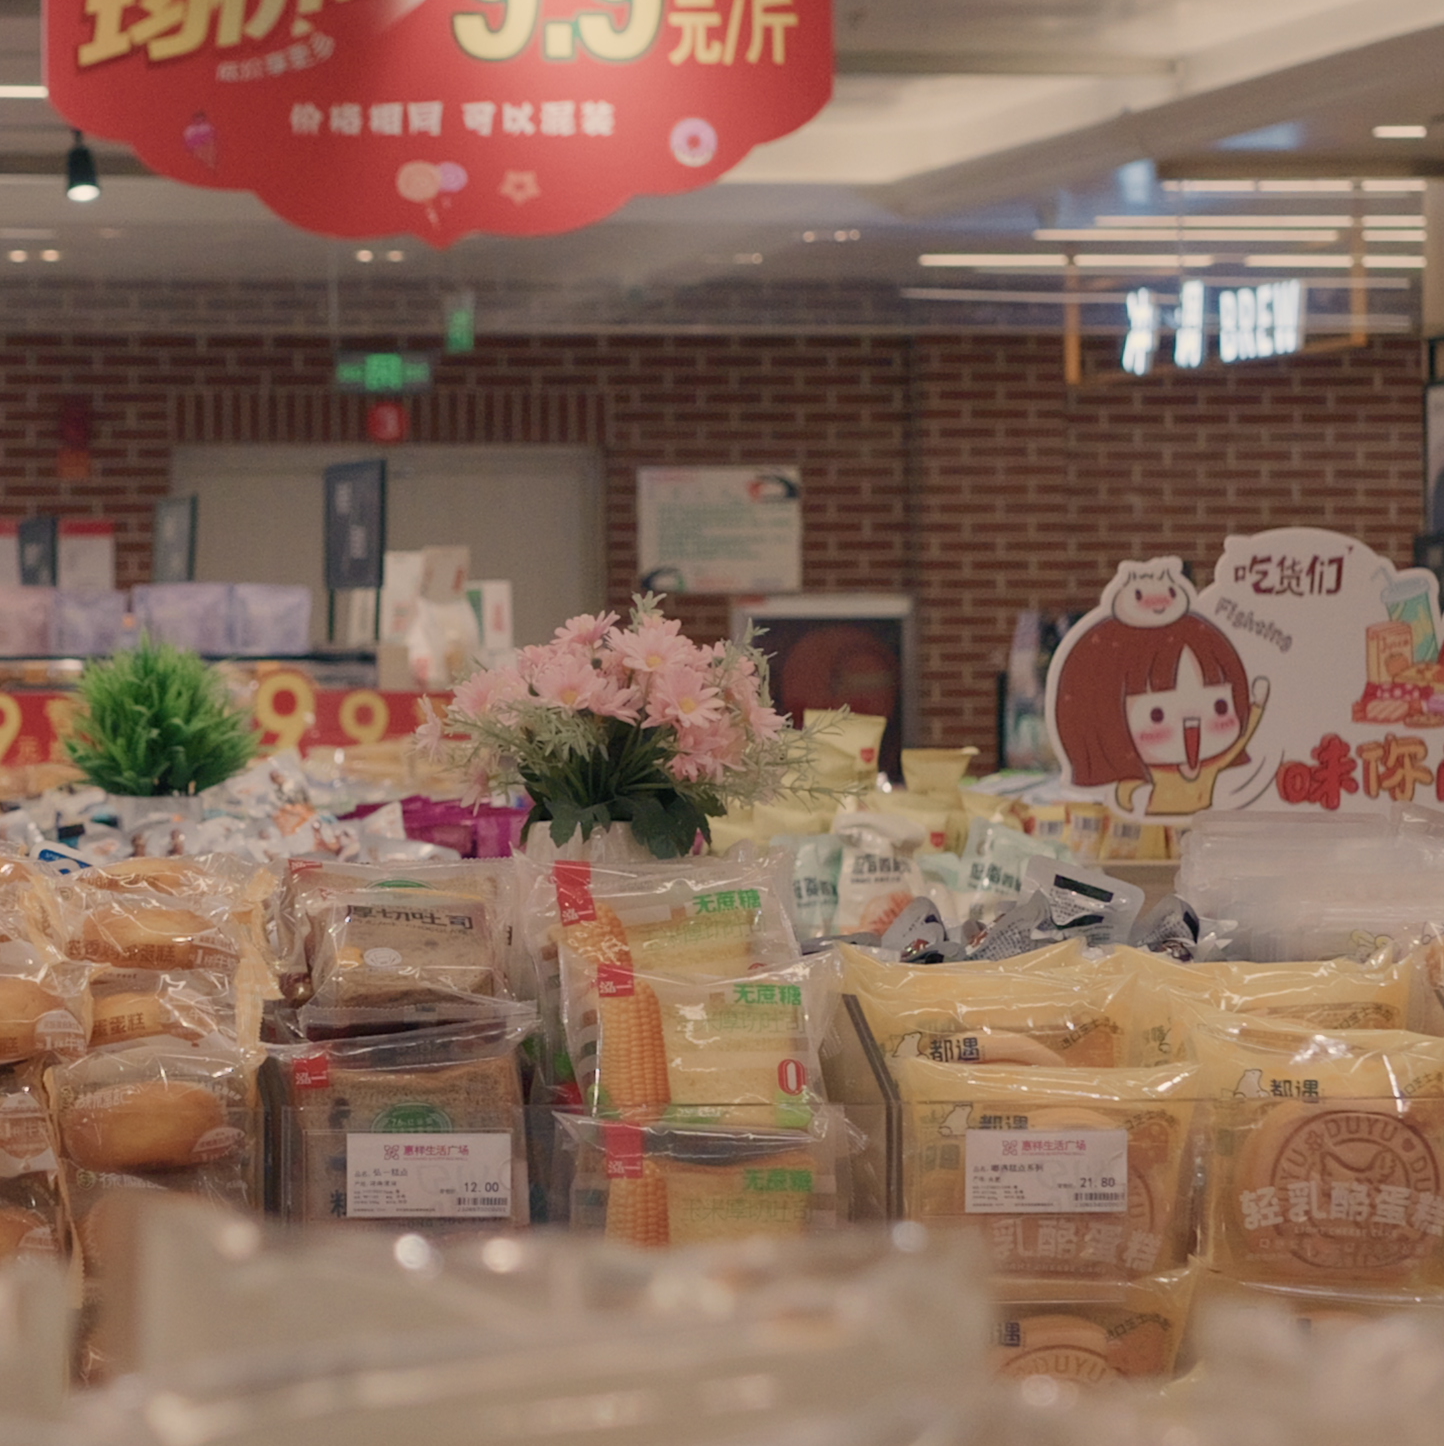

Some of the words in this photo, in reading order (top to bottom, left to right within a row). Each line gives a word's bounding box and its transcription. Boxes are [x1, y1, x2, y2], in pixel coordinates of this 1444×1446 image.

[1233, 554, 1346, 597] 吃货们
[692, 889, 763, 916] 无蔗糖
[346, 904, 474, 931] 厚切吐司
[732, 983, 802, 1006] 无蔗糖
[929, 1036, 981, 1063] 都遇
[1322, 1115, 1399, 1143] DUYU
[402, 1144, 470, 1157] 惠祥生活广场
[1021, 1139, 1087, 1152] 惠祥生活广场
[464, 1181, 500, 1193] 12.00
[743, 1168, 815, 1192] 无蔗糖
[1079, 1177, 1116, 1188] 21.80
[991, 1217, 1163, 1272] 乳酪蛋糕
